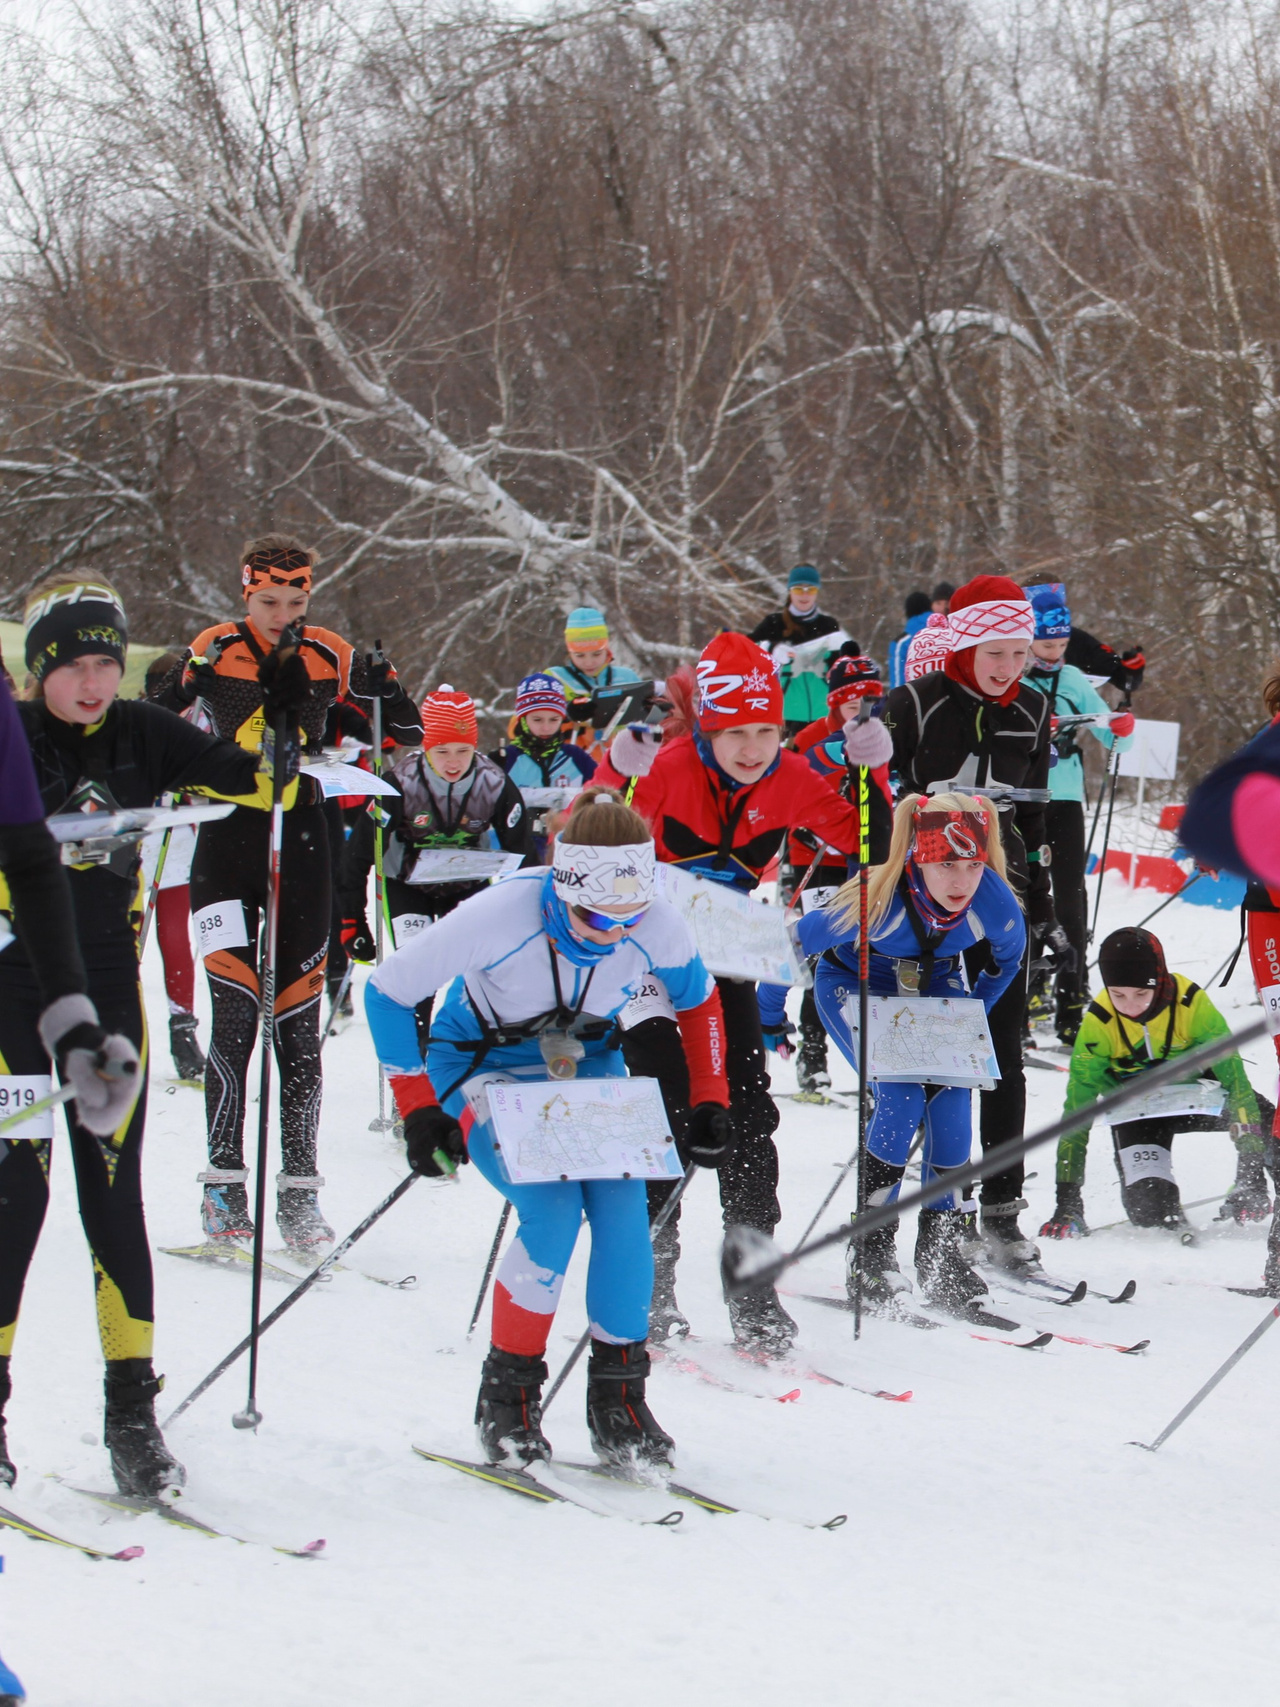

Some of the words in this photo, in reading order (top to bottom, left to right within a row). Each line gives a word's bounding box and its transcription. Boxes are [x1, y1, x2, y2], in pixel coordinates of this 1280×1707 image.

[200, 914, 223, 934] 938
[404, 919, 426, 929] 947
[262, 965, 275, 1051] NORDWAY
[708, 1017, 722, 1076] NORDSKI
[0, 1088, 35, 1107] 919
[1133, 1151, 1159, 1163] 935
